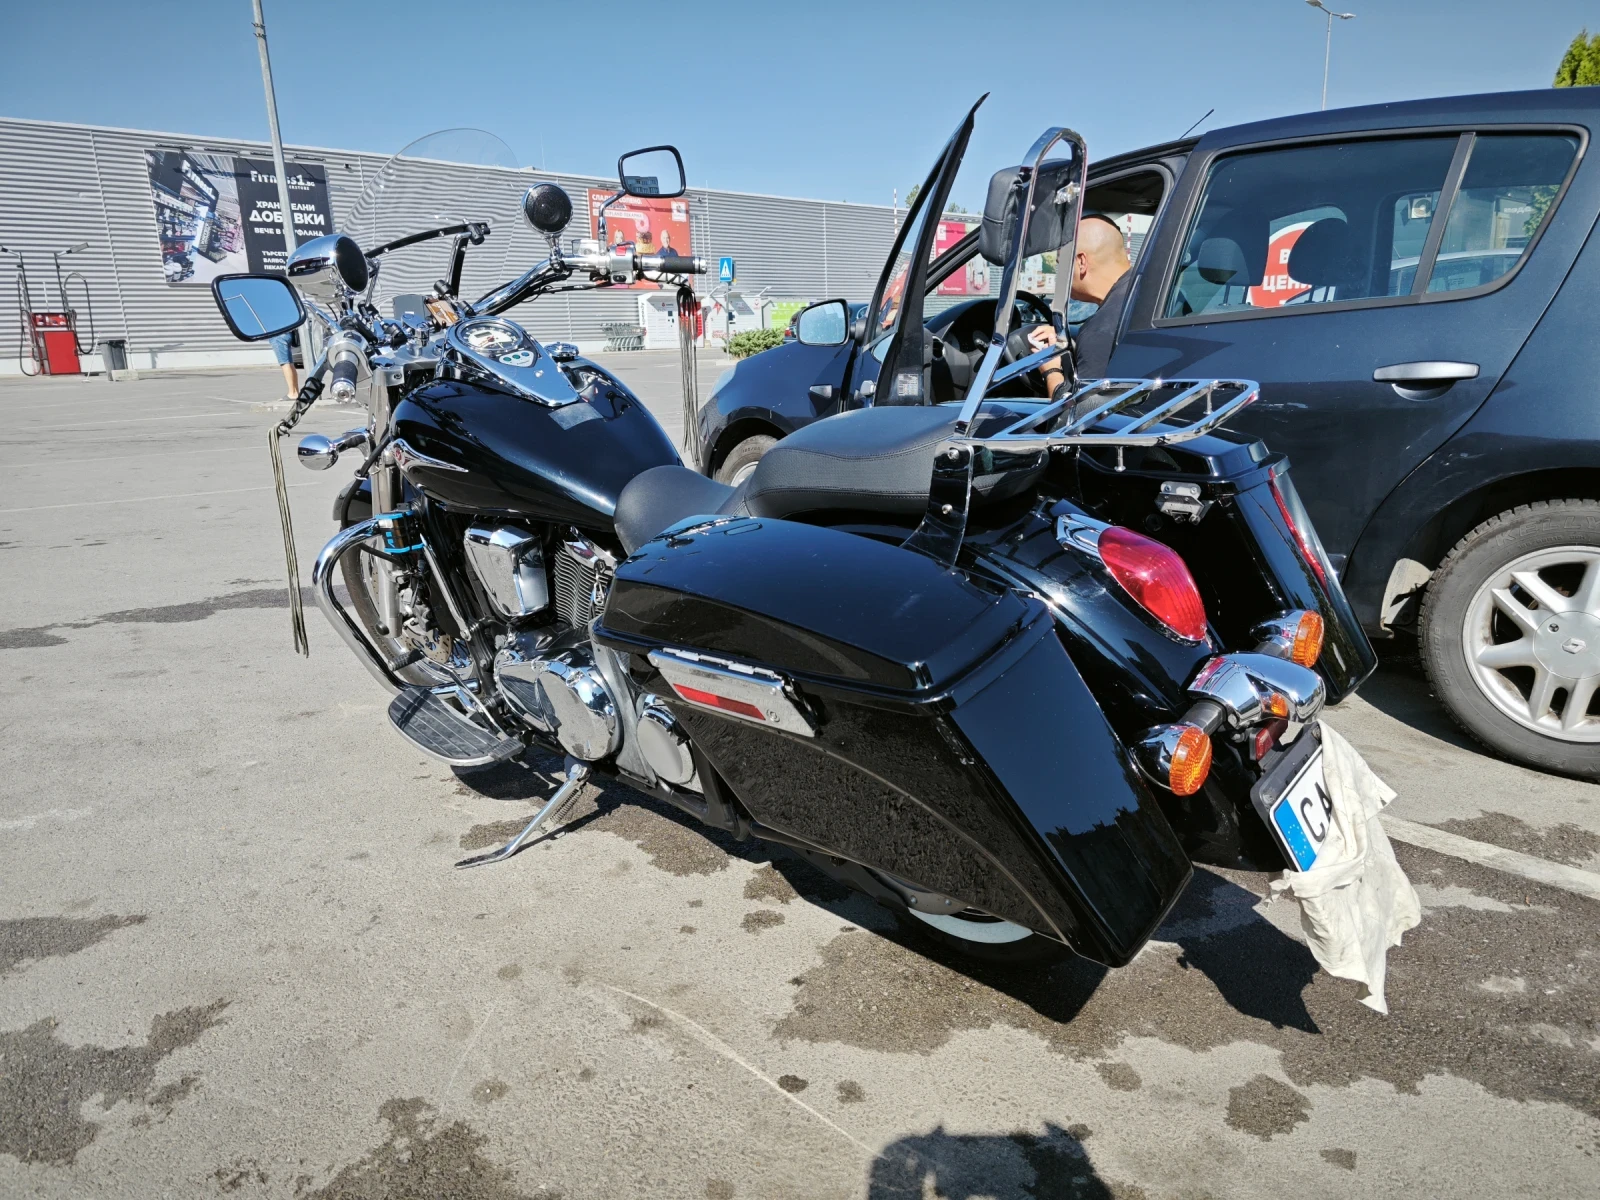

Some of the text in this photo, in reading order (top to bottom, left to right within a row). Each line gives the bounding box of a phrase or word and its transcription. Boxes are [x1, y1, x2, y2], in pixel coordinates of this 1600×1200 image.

[255, 200, 316, 212] ХРАНЕЛНИ
[249, 209, 325, 226] ДОБВКИ
[254, 227, 274, 235] ВЕЧЕ
